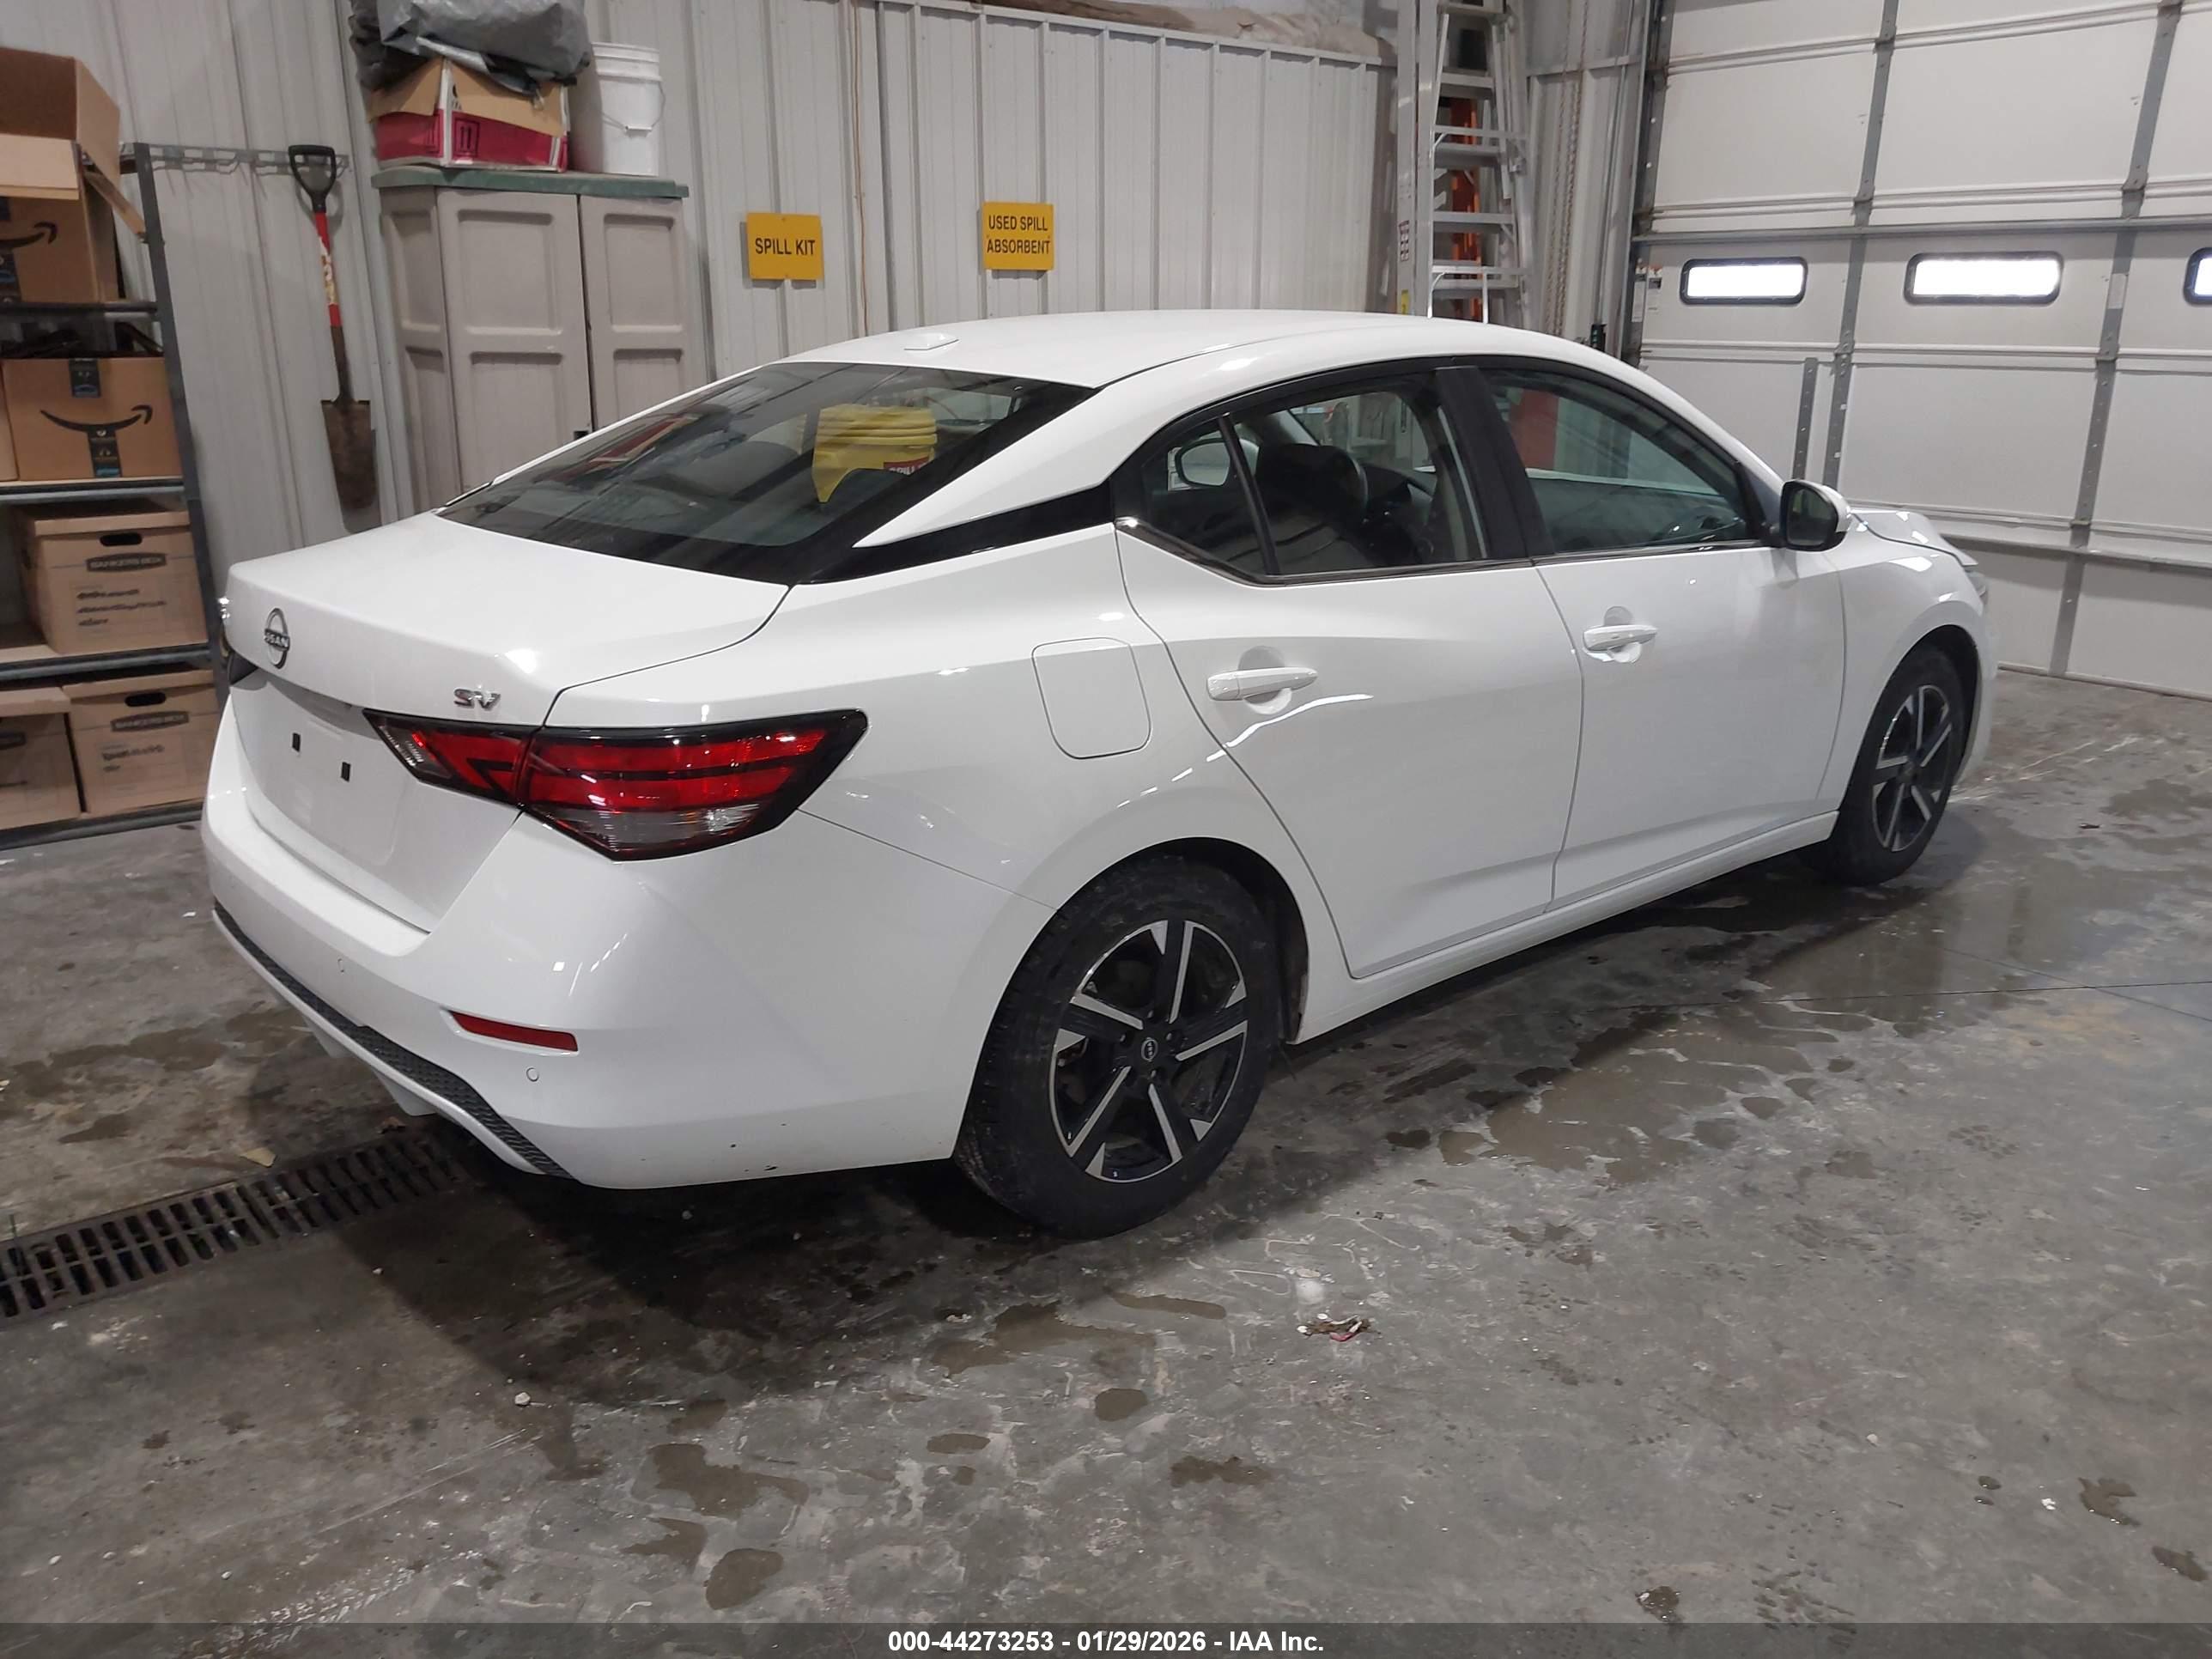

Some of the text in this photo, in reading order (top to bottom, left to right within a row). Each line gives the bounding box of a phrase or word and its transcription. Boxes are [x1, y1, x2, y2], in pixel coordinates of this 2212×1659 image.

[988, 215, 1048, 231] USED SPILL
[755, 237, 815, 256] SPILL KIT
[987, 239, 1049, 255] ABSORBENT
[453, 689, 501, 711] SV
